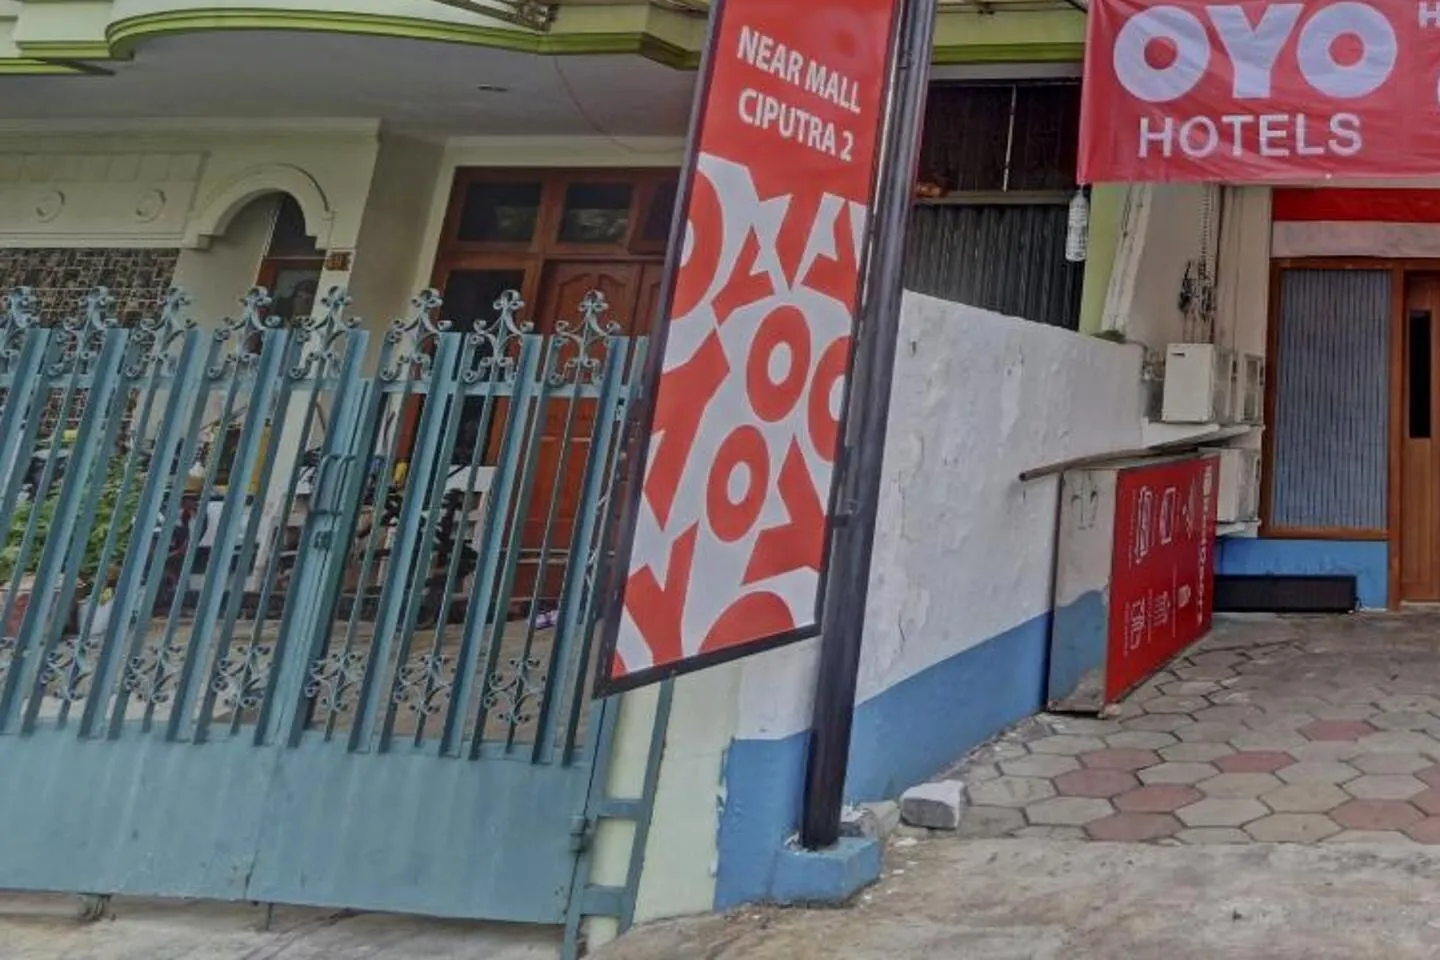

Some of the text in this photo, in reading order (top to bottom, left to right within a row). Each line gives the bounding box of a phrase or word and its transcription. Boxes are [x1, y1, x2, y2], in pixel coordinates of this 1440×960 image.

[736, 24, 861, 114] NEAR MALL
[1112, 0, 1398, 102] OYO
[738, 86, 854, 162] CIPUTRA 2
[1137, 112, 1363, 158] HOTELS
